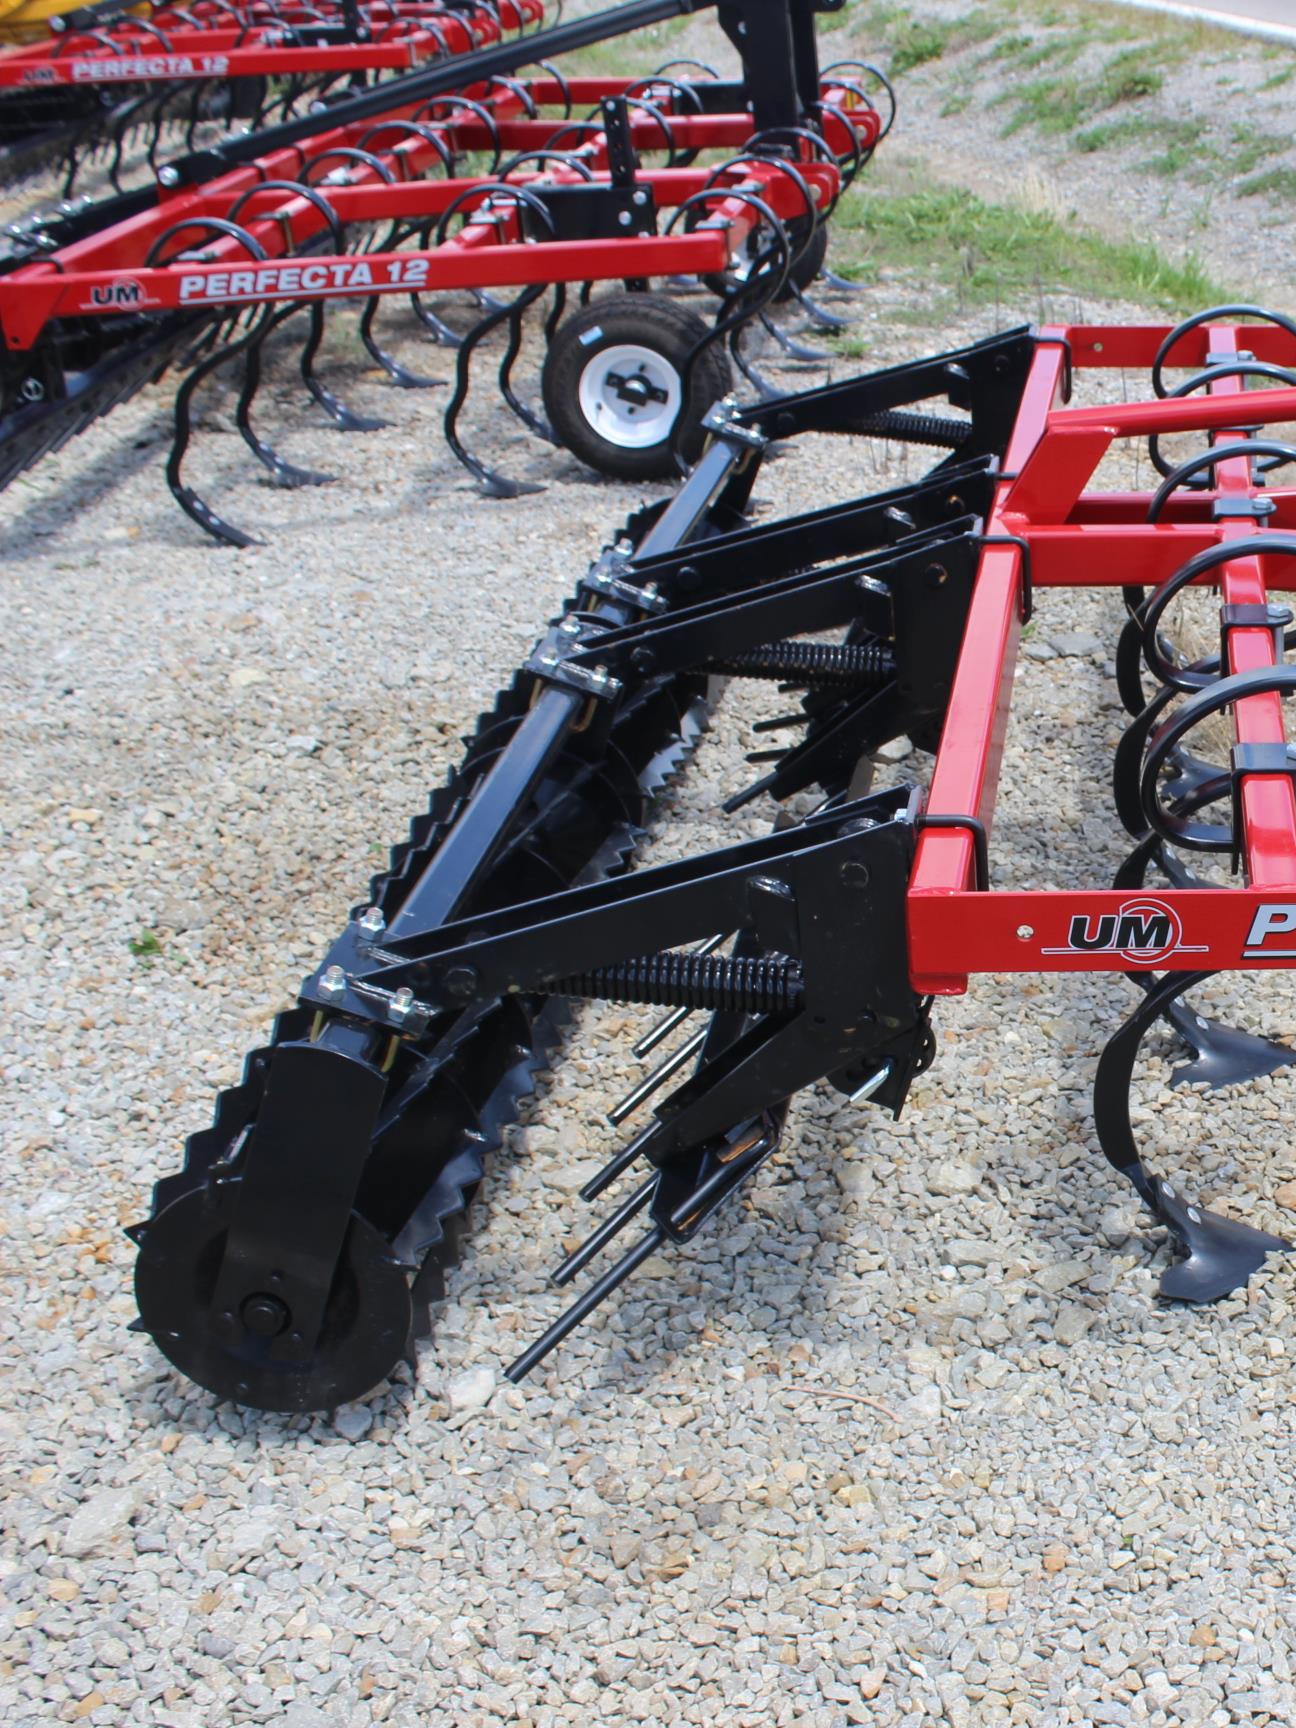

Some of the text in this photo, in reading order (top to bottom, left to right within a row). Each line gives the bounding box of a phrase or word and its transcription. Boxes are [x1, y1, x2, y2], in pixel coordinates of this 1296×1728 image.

[73, 56, 229, 79] PERFECTA 12
[180, 259, 430, 299] PERFECTA 12
[92, 284, 138, 304] UM
[1068, 915, 1172, 949] UM
